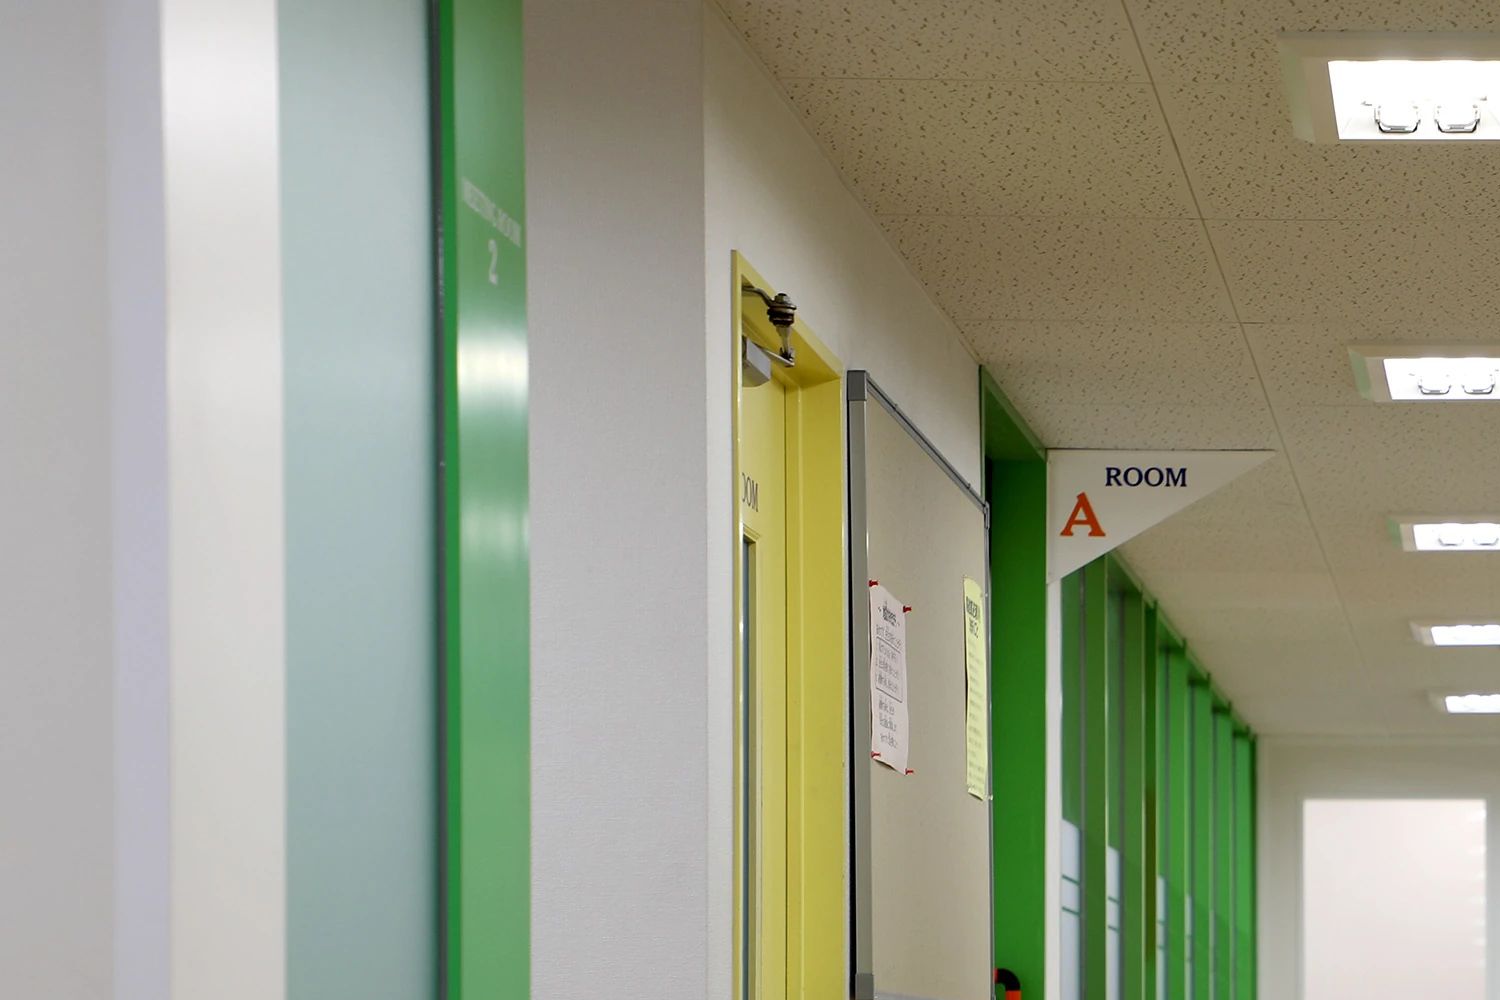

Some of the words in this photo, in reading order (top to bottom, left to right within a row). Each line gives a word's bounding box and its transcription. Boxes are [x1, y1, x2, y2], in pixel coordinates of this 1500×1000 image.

[488, 239, 498, 286] 2
[1105, 466, 1188, 488] ROOM
[1060, 491, 1106, 537] A
